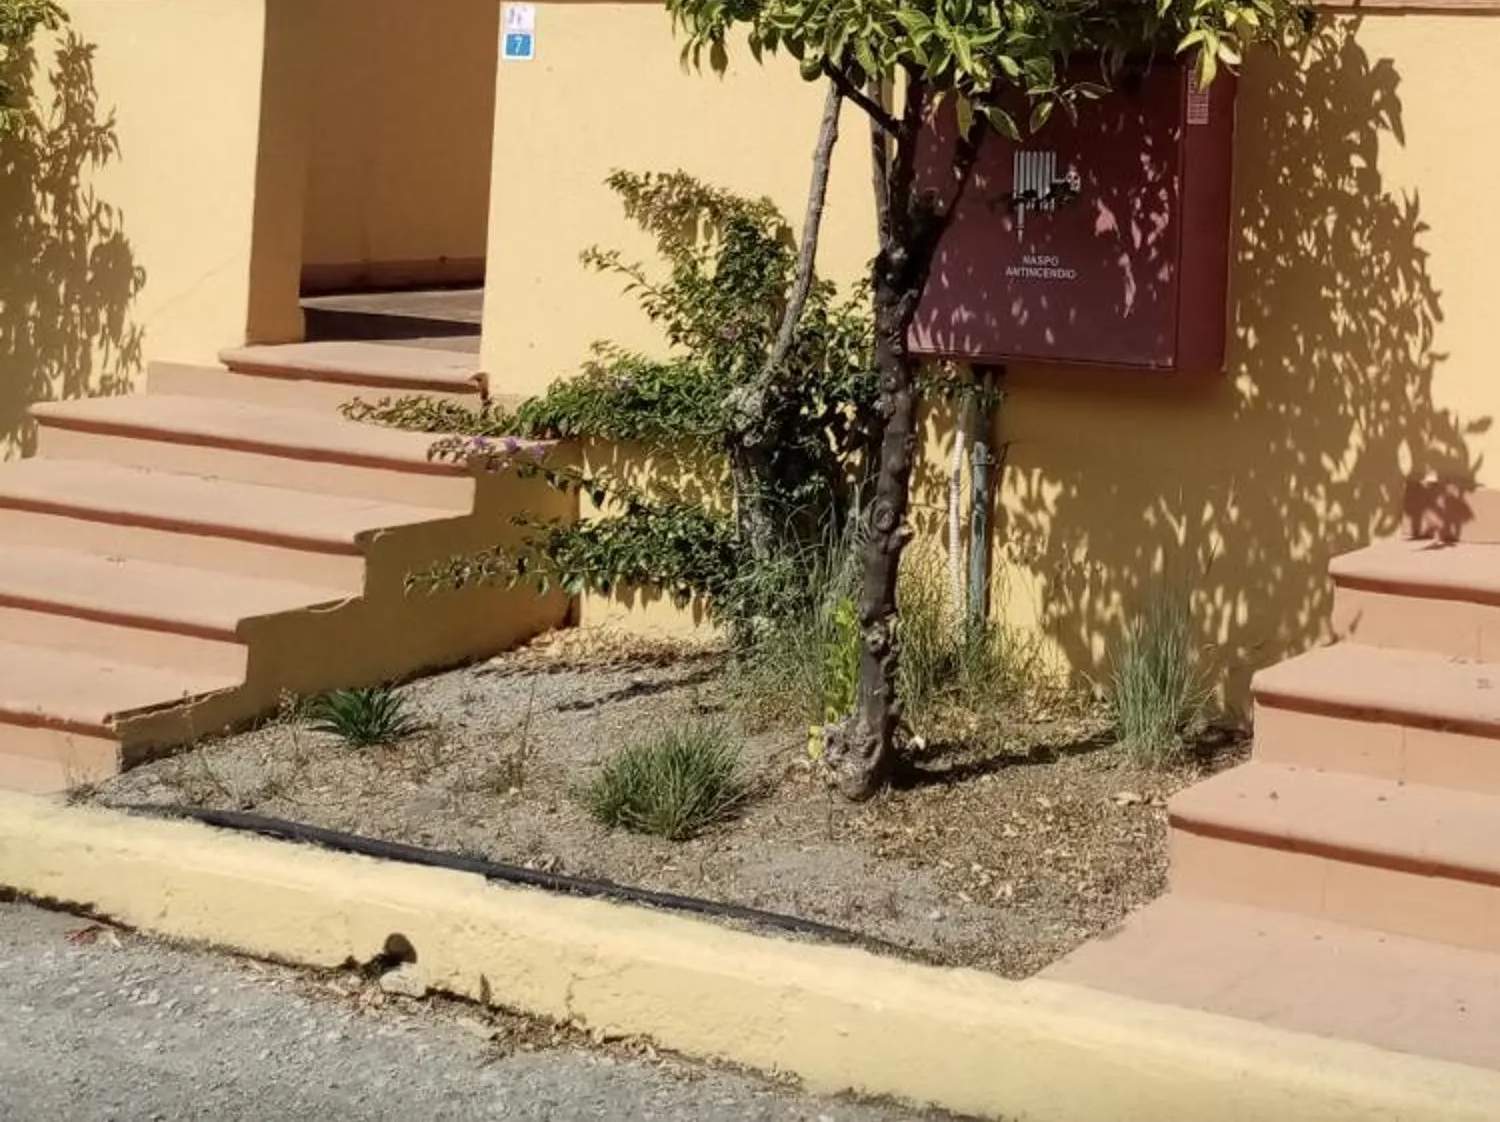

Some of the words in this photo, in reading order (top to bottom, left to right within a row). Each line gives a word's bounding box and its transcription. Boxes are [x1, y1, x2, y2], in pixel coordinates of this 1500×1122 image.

[514, 36, 524, 55] 7
[1023, 255, 1059, 267] NASPO
[1006, 266, 1077, 280] ANTINCENDIO
